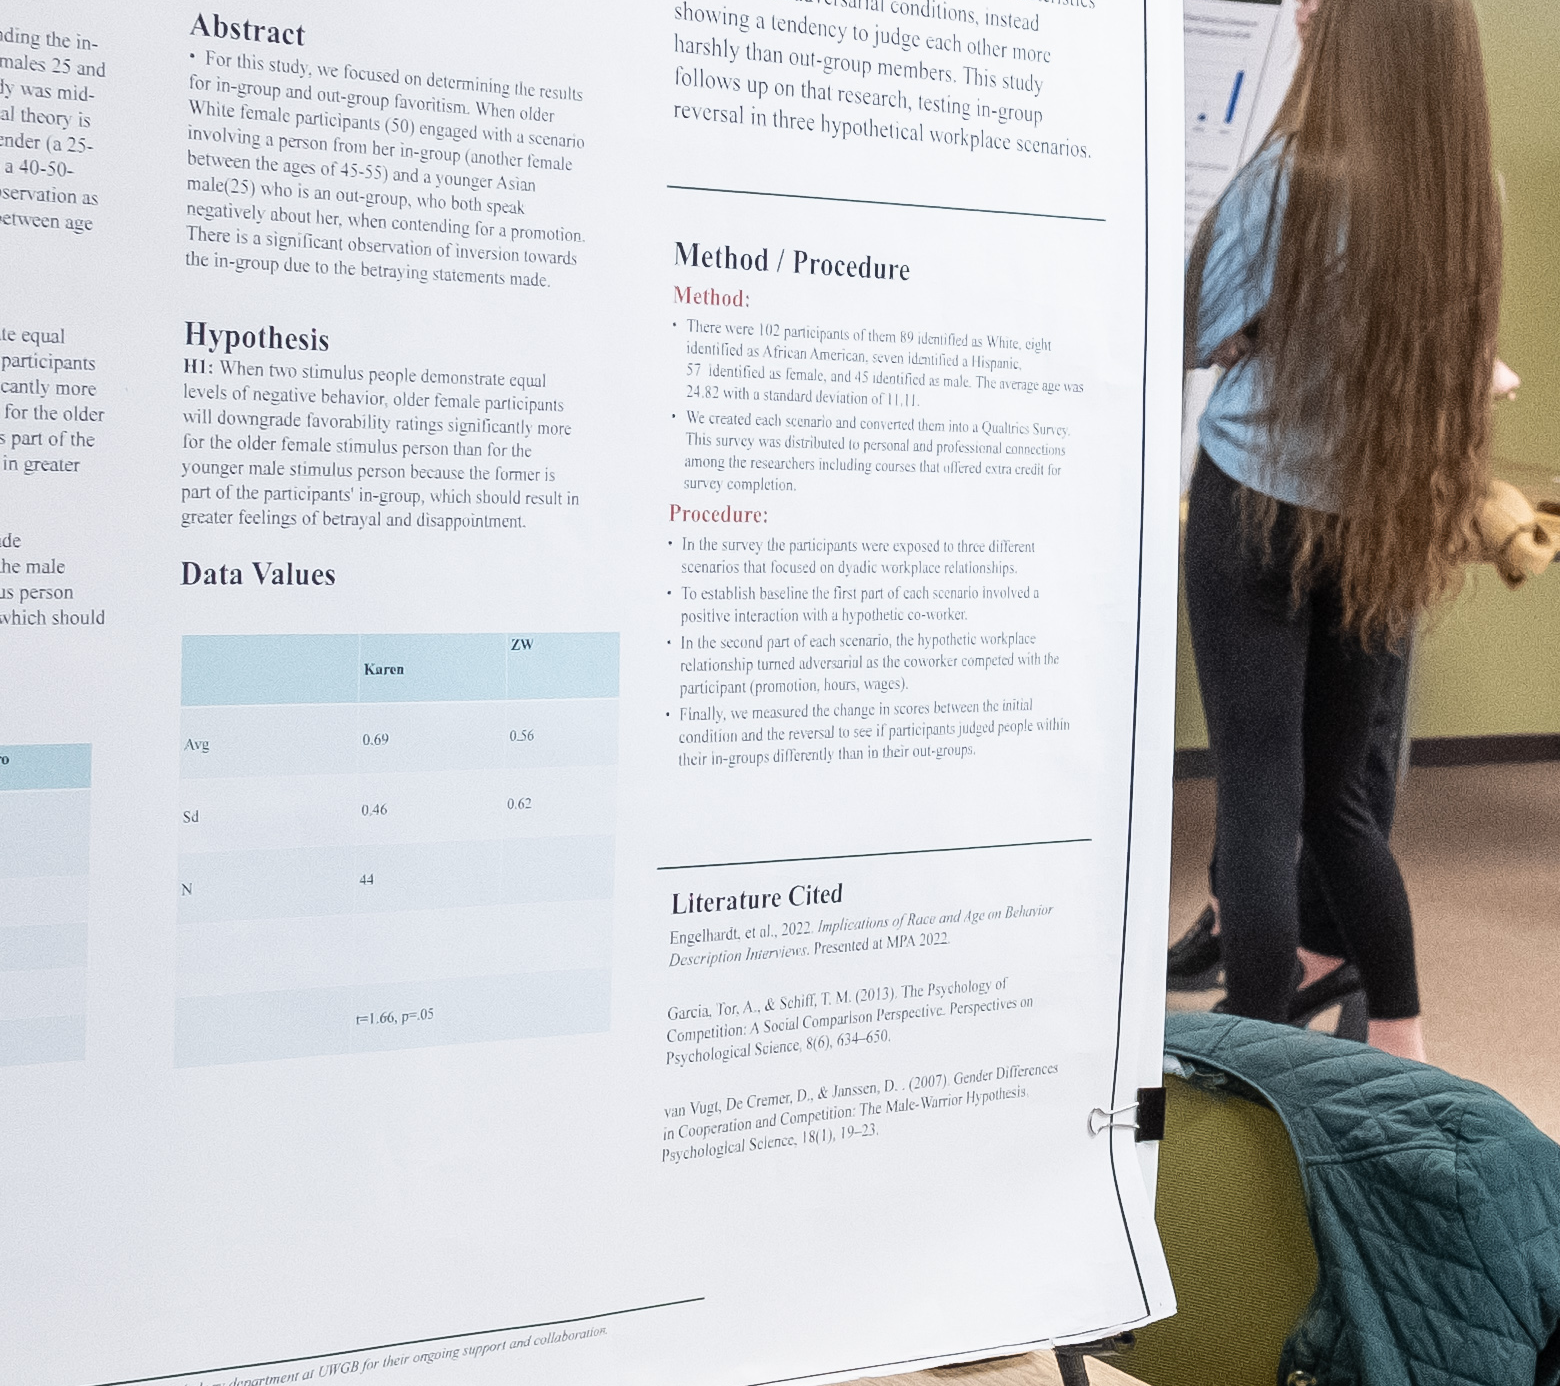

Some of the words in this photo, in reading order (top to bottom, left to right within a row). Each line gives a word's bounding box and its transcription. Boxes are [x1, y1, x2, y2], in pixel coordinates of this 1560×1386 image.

[189, 13, 306, 46] Abstract
[205, 50, 233, 67] For
[237, 53, 264, 71] this
[268, 58, 312, 79] study,
[317, 66, 339, 78] we
[344, 64, 400, 84] focused
[404, 74, 422, 87] on
[426, 72, 510, 99] determining
[514, 81, 536, 97] the
[539, 86, 583, 101] results
[674, 241, 769, 272] Method
[776, 248, 785, 273] /
[793, 250, 910, 281] Procedure
[673, 286, 750, 308] Method:
[21, 328, 65, 347] equal
[185, 321, 329, 354] Hypothesis
[183, 358, 213, 374] H1:
[219, 360, 264, 377] When
[269, 365, 298, 378] two
[302, 364, 364, 380] stimulus
[368, 368, 417, 387] people
[420, 369, 505, 386] demonstrate
[509, 373, 546, 391] equal
[670, 504, 768, 523] Procedure:
[179, 562, 243, 586] Data
[251, 561, 336, 586] Values
[510, 638, 535, 651] ZW
[363, 663, 405, 676] Karen
[183, 738, 211, 753] Avg
[361, 733, 390, 747] 0.69
[508, 729, 536, 743] 0.56
[182, 810, 201, 823] Sd
[360, 803, 389, 817] 0.46
[506, 797, 533, 811] 0.62
[180, 883, 194, 896] N
[358, 873, 376, 886] 44
[672, 891, 782, 914] Literature
[788, 883, 843, 907] Cited
[666, 1042, 751, 1067] Psychological
[754, 1040, 802, 1056] Science,
[806, 1035, 833, 1052] 8(6),
[318, 1360, 360, 1377] UWGB
[359, 1358, 380, 1375] for
[382, 1355, 410, 1368] their
[412, 1347, 460, 1365] ongoing
[461, 1340, 507, 1358] support
[508, 1335, 533, 1349] and
[533, 1326, 608, 1346] collaboration.
